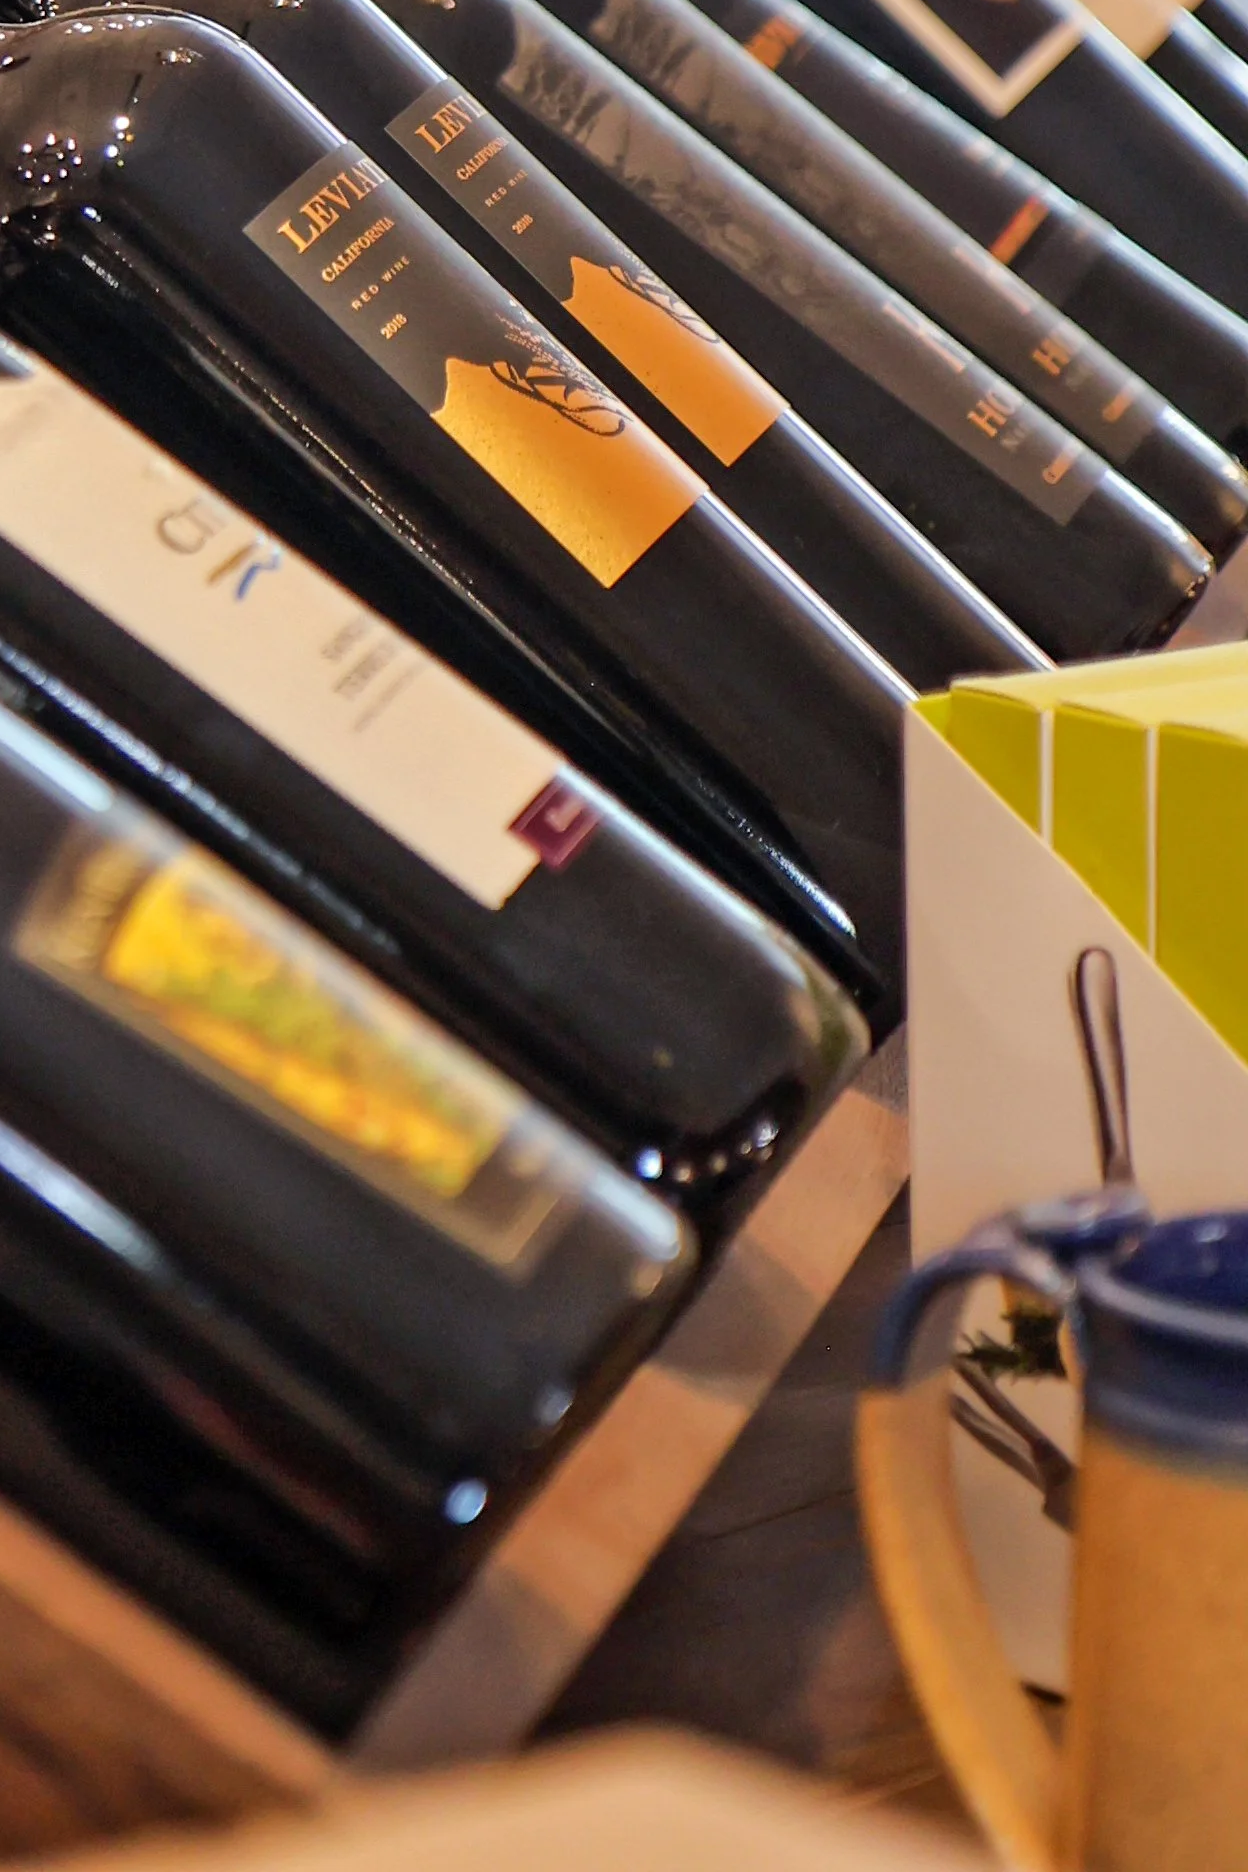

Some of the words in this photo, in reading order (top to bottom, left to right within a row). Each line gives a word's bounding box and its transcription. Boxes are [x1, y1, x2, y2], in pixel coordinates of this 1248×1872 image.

[321, 216, 395, 283] CALIFORNIA
[351, 284, 380, 312] RED
[381, 255, 411, 283] WINE
